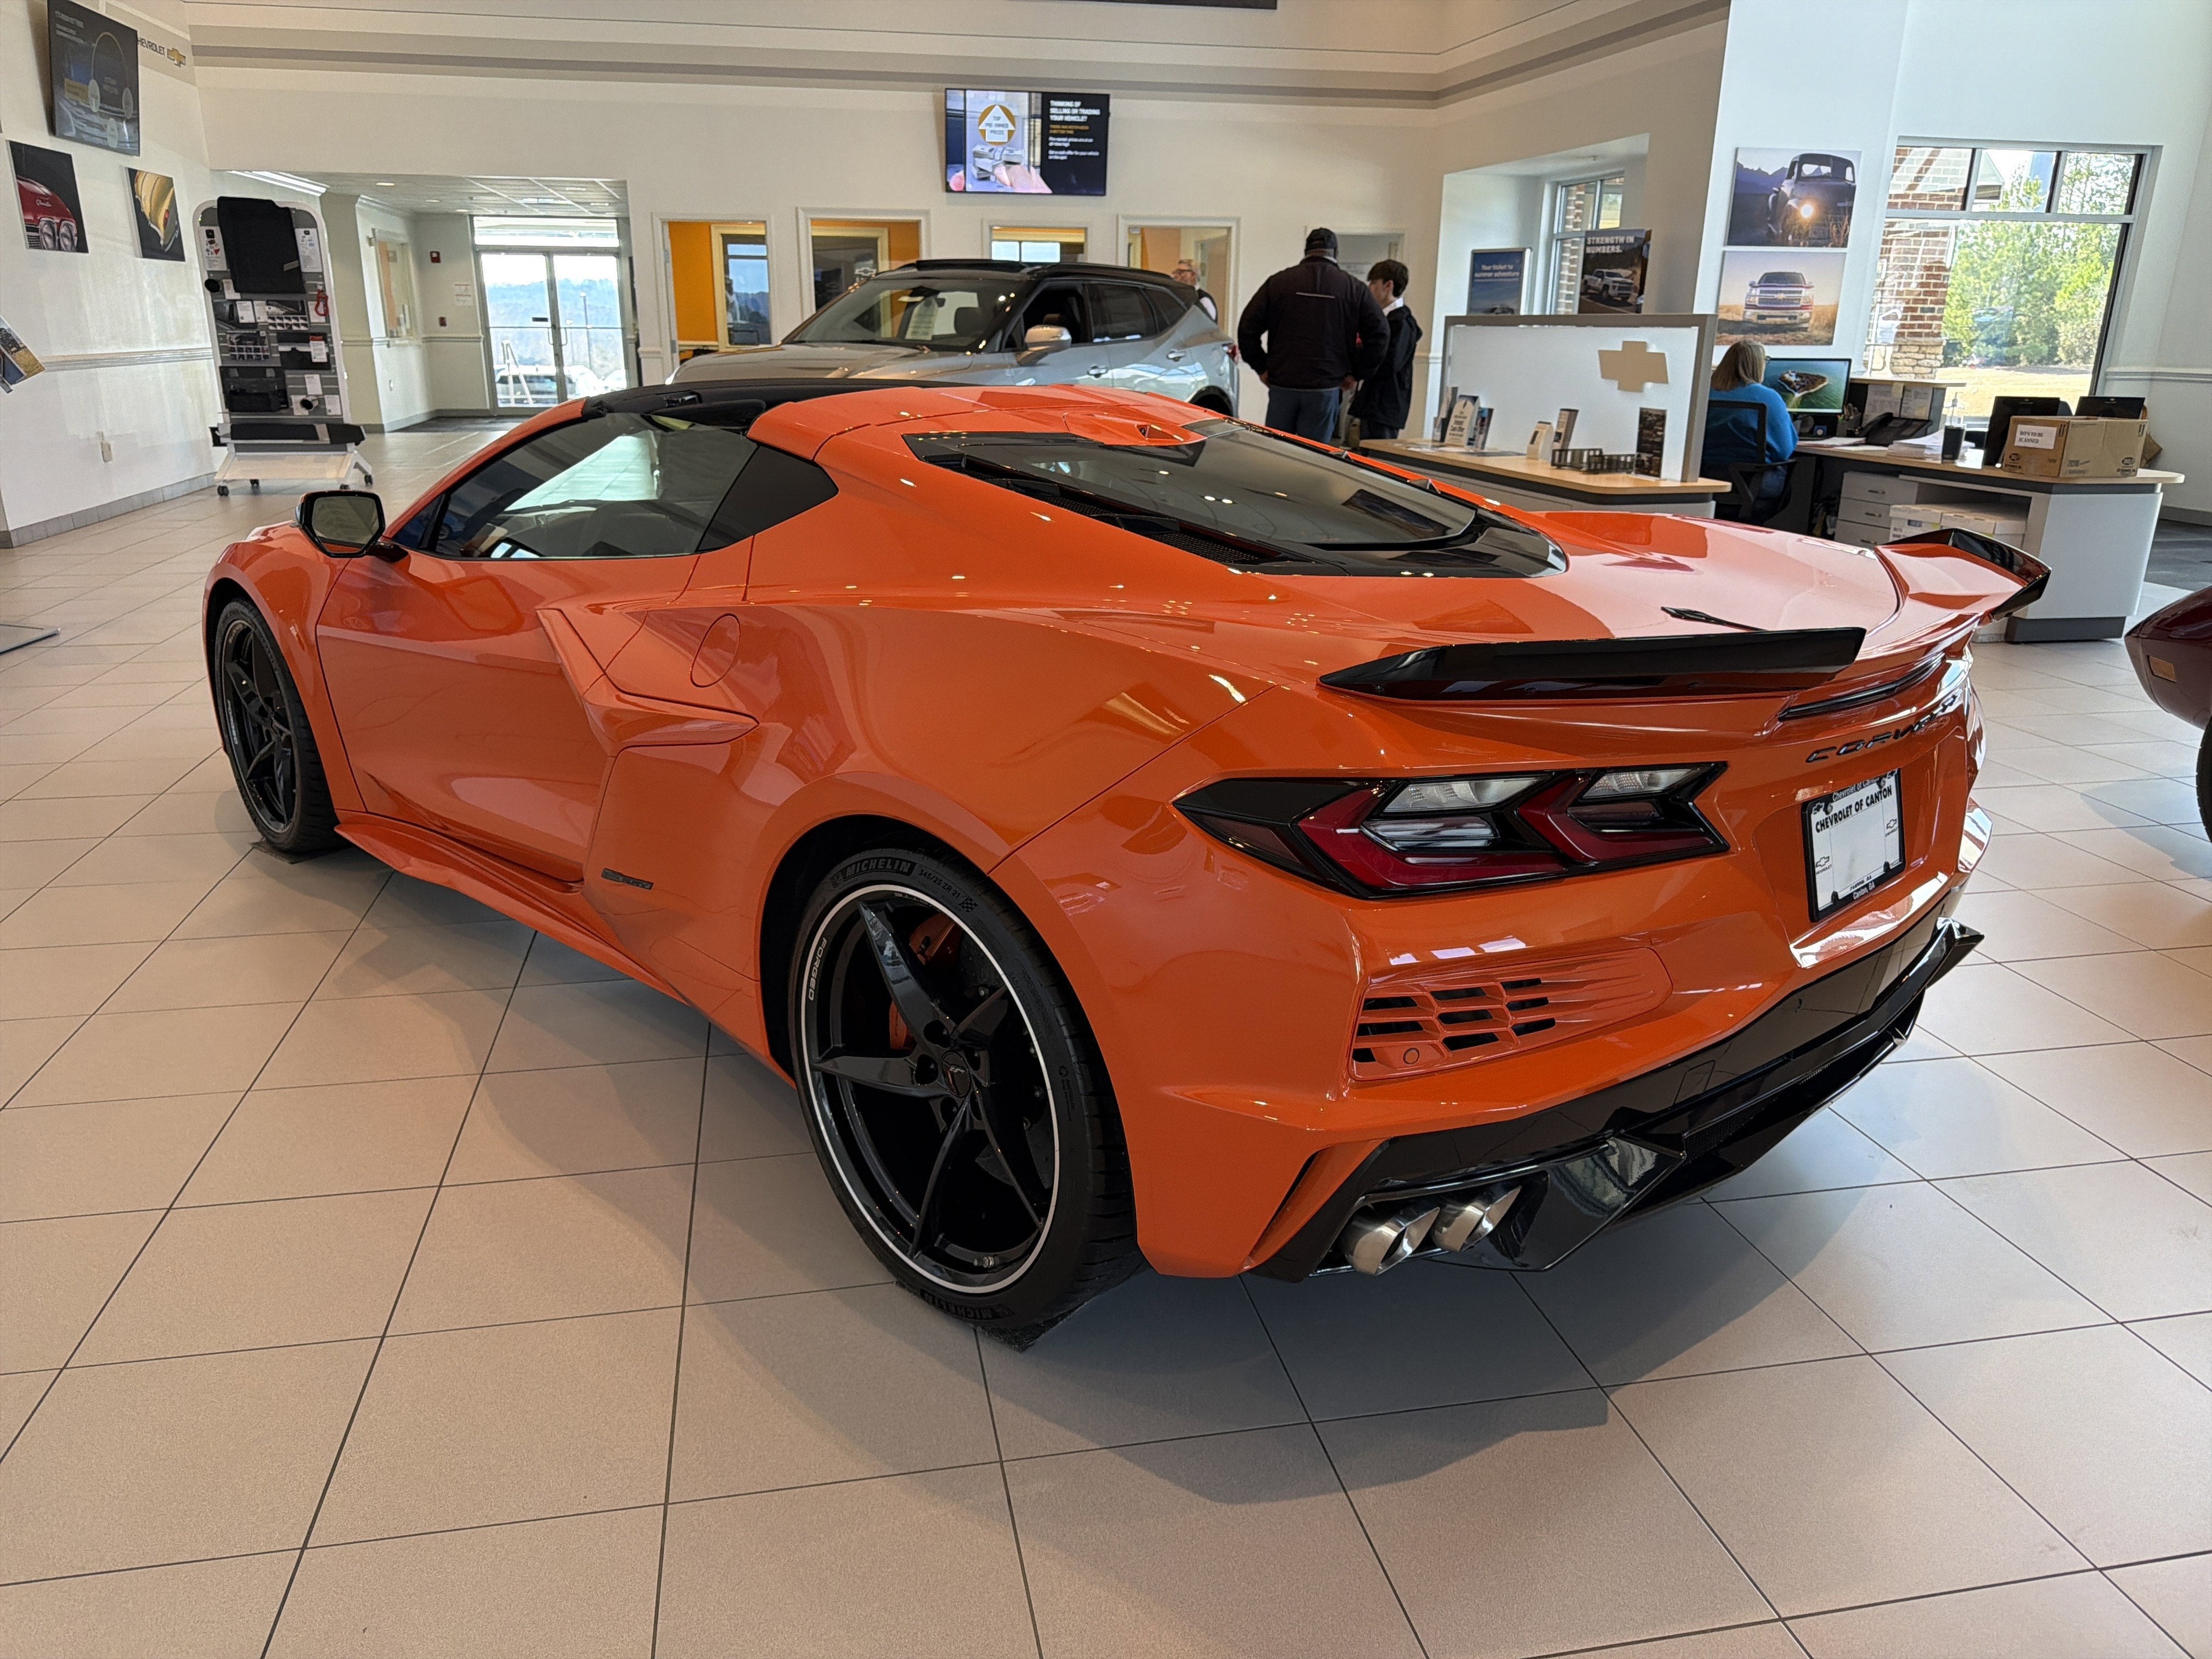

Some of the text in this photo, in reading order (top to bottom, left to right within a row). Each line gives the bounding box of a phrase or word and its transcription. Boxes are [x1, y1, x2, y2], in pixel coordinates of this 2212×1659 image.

[138, 37, 165, 56] HEVROLET
[1587, 236, 1624, 245] STRENGTH
[1815, 784, 1892, 833] CHEVROLET OF CANTON
[845, 858, 911, 879] MICHELIN
[918, 869, 961, 899] 345/25 ZR 21
[808, 937, 827, 1001] FORGED
